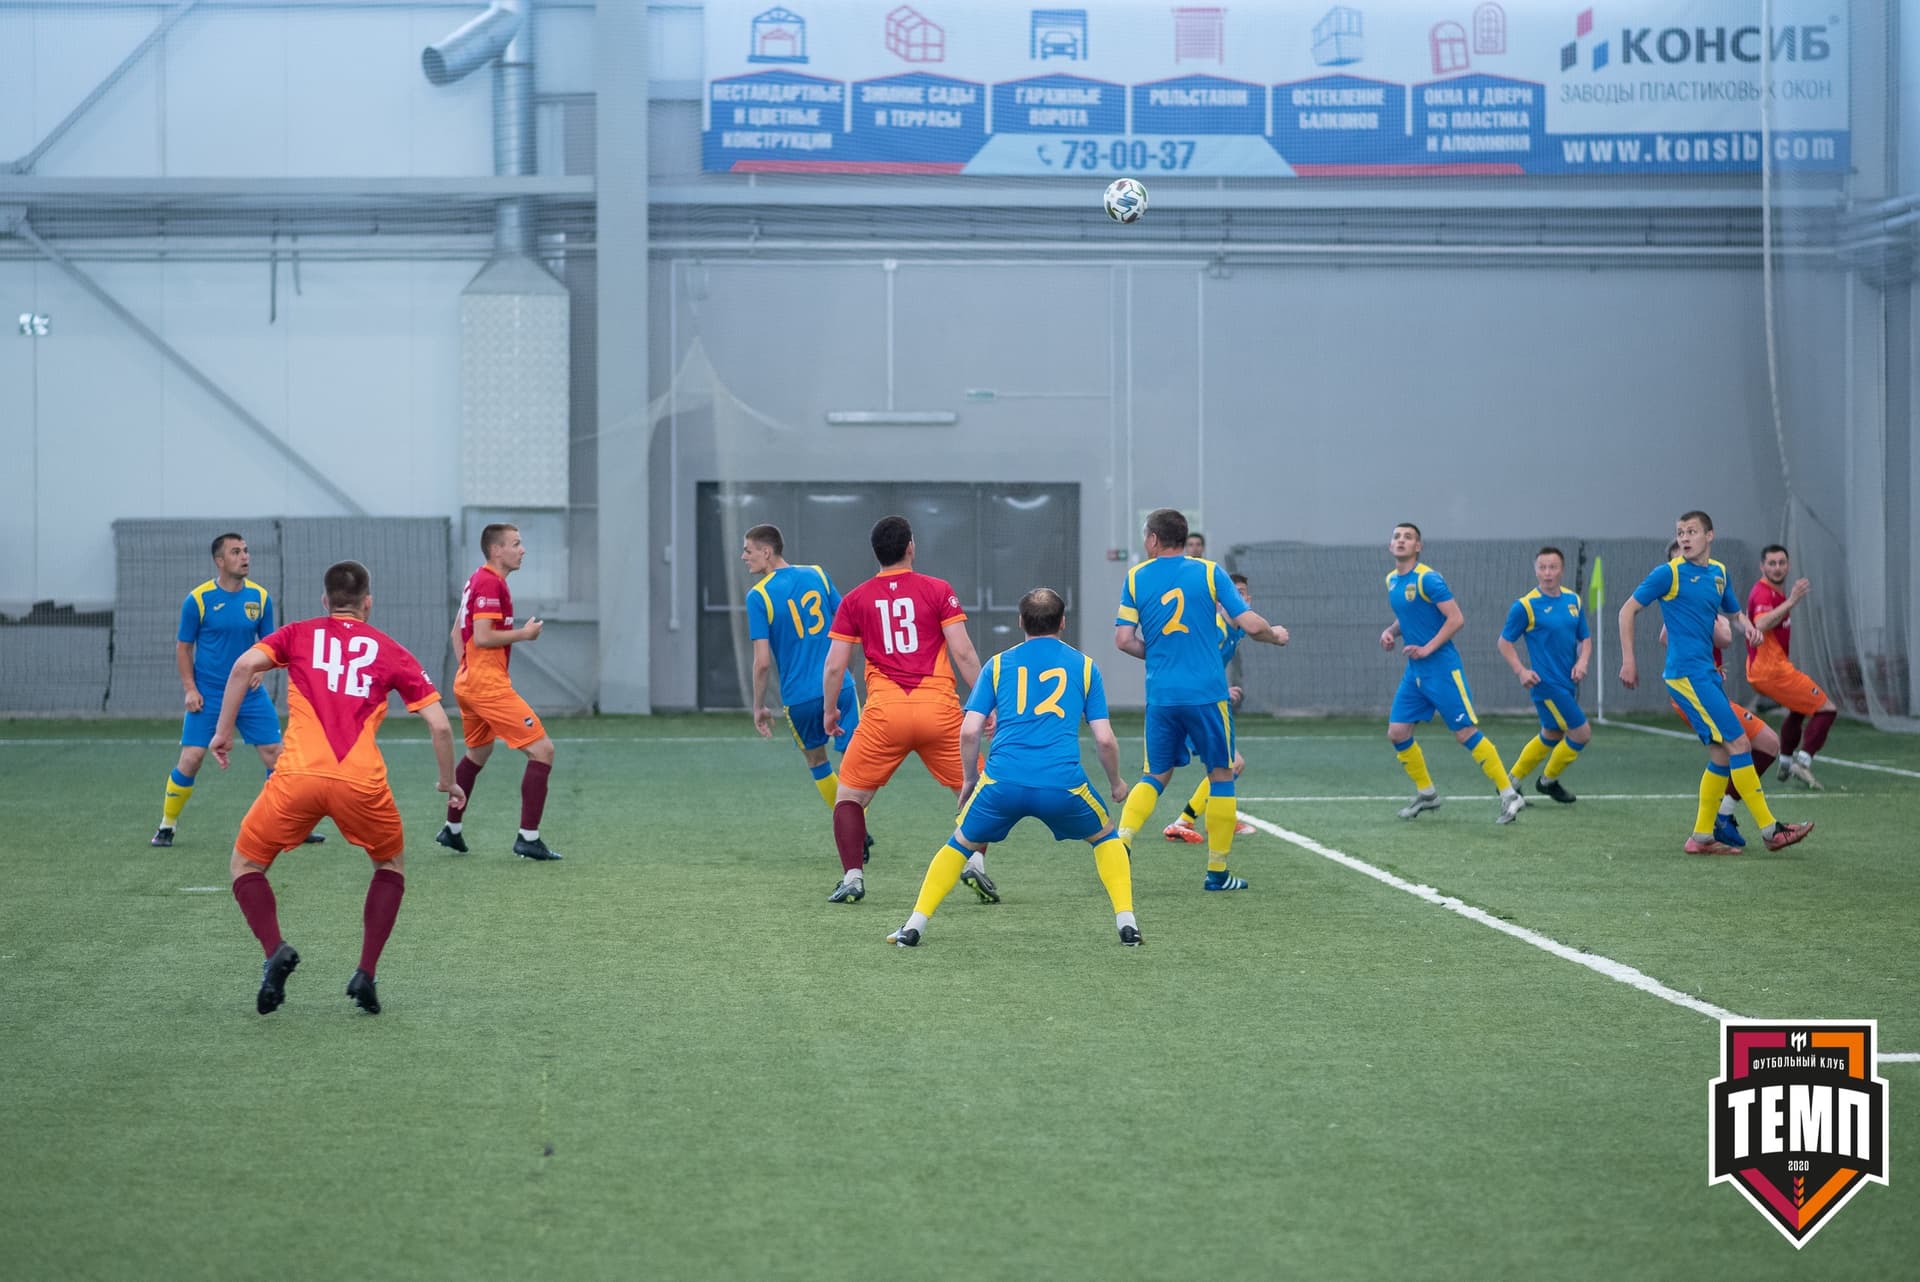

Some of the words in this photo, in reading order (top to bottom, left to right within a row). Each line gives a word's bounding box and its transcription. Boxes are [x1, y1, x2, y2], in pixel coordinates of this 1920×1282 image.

[1621, 26, 1831, 64] КОНСИБ
[713, 83, 842, 103] НЕСТАНДАРТНЫЕ
[927, 87, 976, 105] САДЫ
[1015, 87, 1102, 105] ГАРАЖНЫЕ
[1150, 88, 1248, 106] РОЛЬСТАВНИ
[1292, 88, 1384, 106] ОСТЕКЛЕНИЕ
[1424, 88, 1463, 105] ОКНА
[1468, 88, 1479, 104] И
[1484, 87, 1533, 107] ДВЕРИ
[1560, 81, 1634, 104] ЗАВОДЫ
[1782, 79, 1832, 99] ОКОН
[733, 108, 746, 125] И
[748, 108, 820, 127] ЦВЕТНЫЕ
[875, 109, 887, 126] И
[891, 109, 962, 127] ТЕРРАСЫ
[1028, 108, 1088, 127] ВОРОТА
[1300, 112, 1379, 129] БАЛКОНОВ
[1427, 111, 1447, 128] ИЗ
[1452, 111, 1530, 128] ПЛАСТИКА
[722, 132, 833, 150] КОНСТРУКЦИИ
[1427, 134, 1439, 152] И
[1441, 134, 1531, 152] АЛЮМИНИЯ
[1562, 133, 1835, 163] www.konsibcom
[1061, 139, 1197, 171] 73-00-37
[787, 590, 825, 639] 13
[1161, 587, 1190, 636] 2
[875, 597, 919, 655] 13
[312, 628, 379, 698] 42
[1016, 665, 1068, 719] 12
